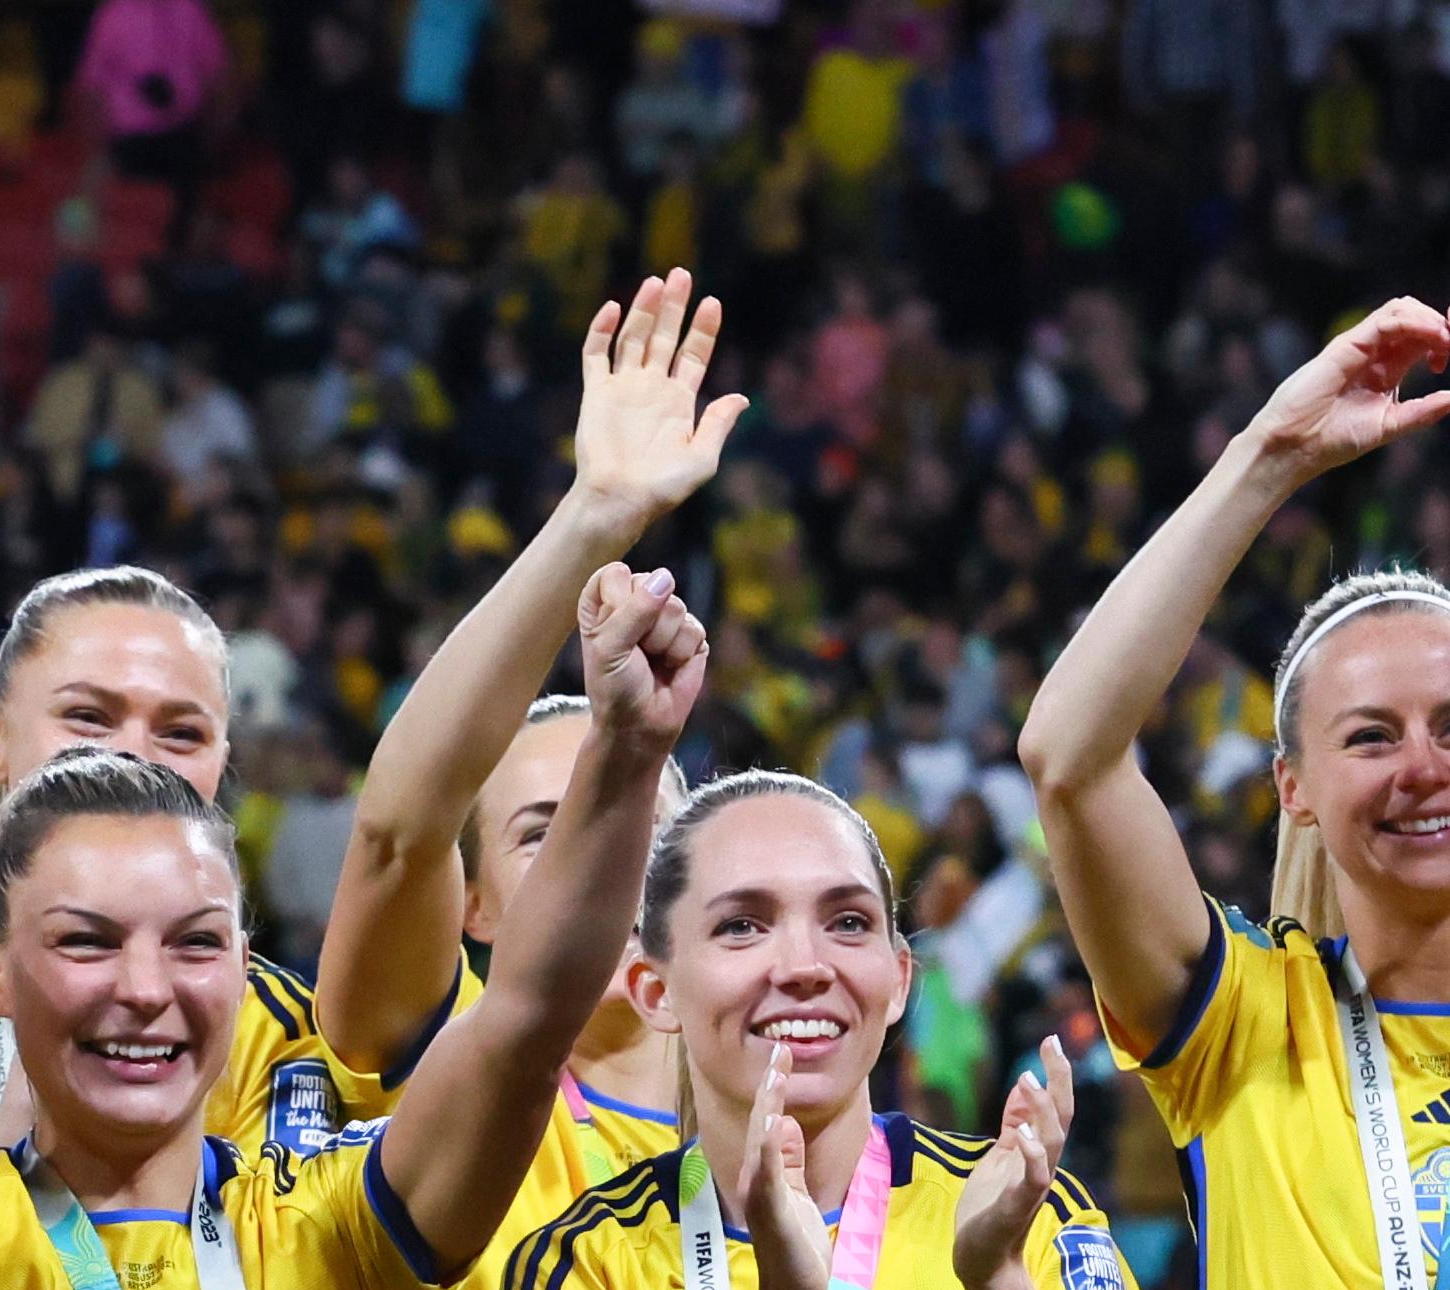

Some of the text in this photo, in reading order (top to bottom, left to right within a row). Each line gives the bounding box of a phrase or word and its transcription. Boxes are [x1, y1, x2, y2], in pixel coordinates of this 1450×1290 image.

[1369, 1107, 1393, 1172] WORLD
[1382, 1175, 1401, 1216] CUP
[695, 1231, 712, 1268] FIFA
